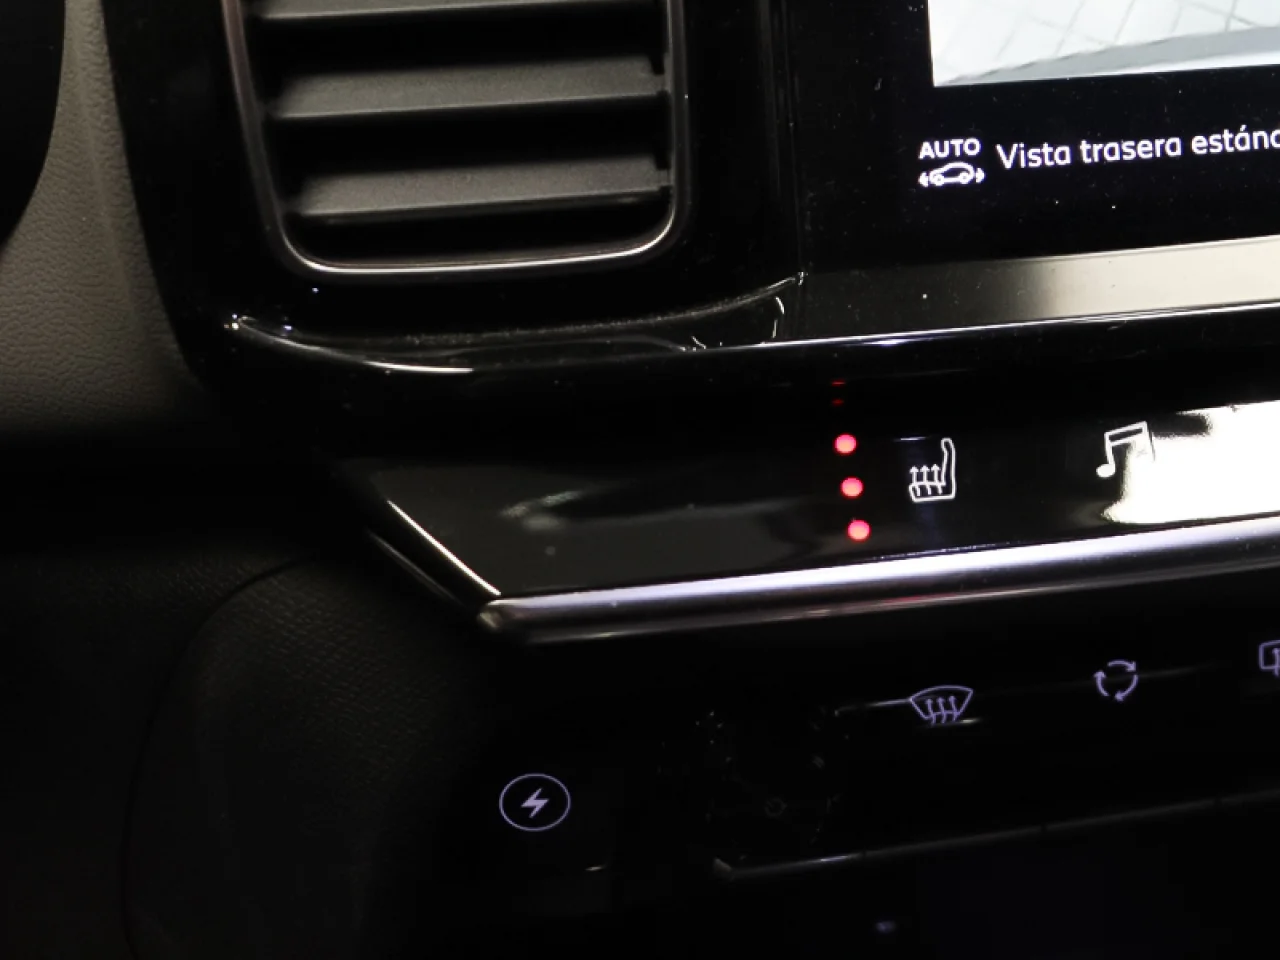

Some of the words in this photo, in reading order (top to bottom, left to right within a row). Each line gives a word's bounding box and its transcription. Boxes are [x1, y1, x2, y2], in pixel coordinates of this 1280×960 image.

[918, 137, 982, 160] AUTO
[996, 142, 1072, 170] Vista
[1080, 137, 1183, 164] trasera
